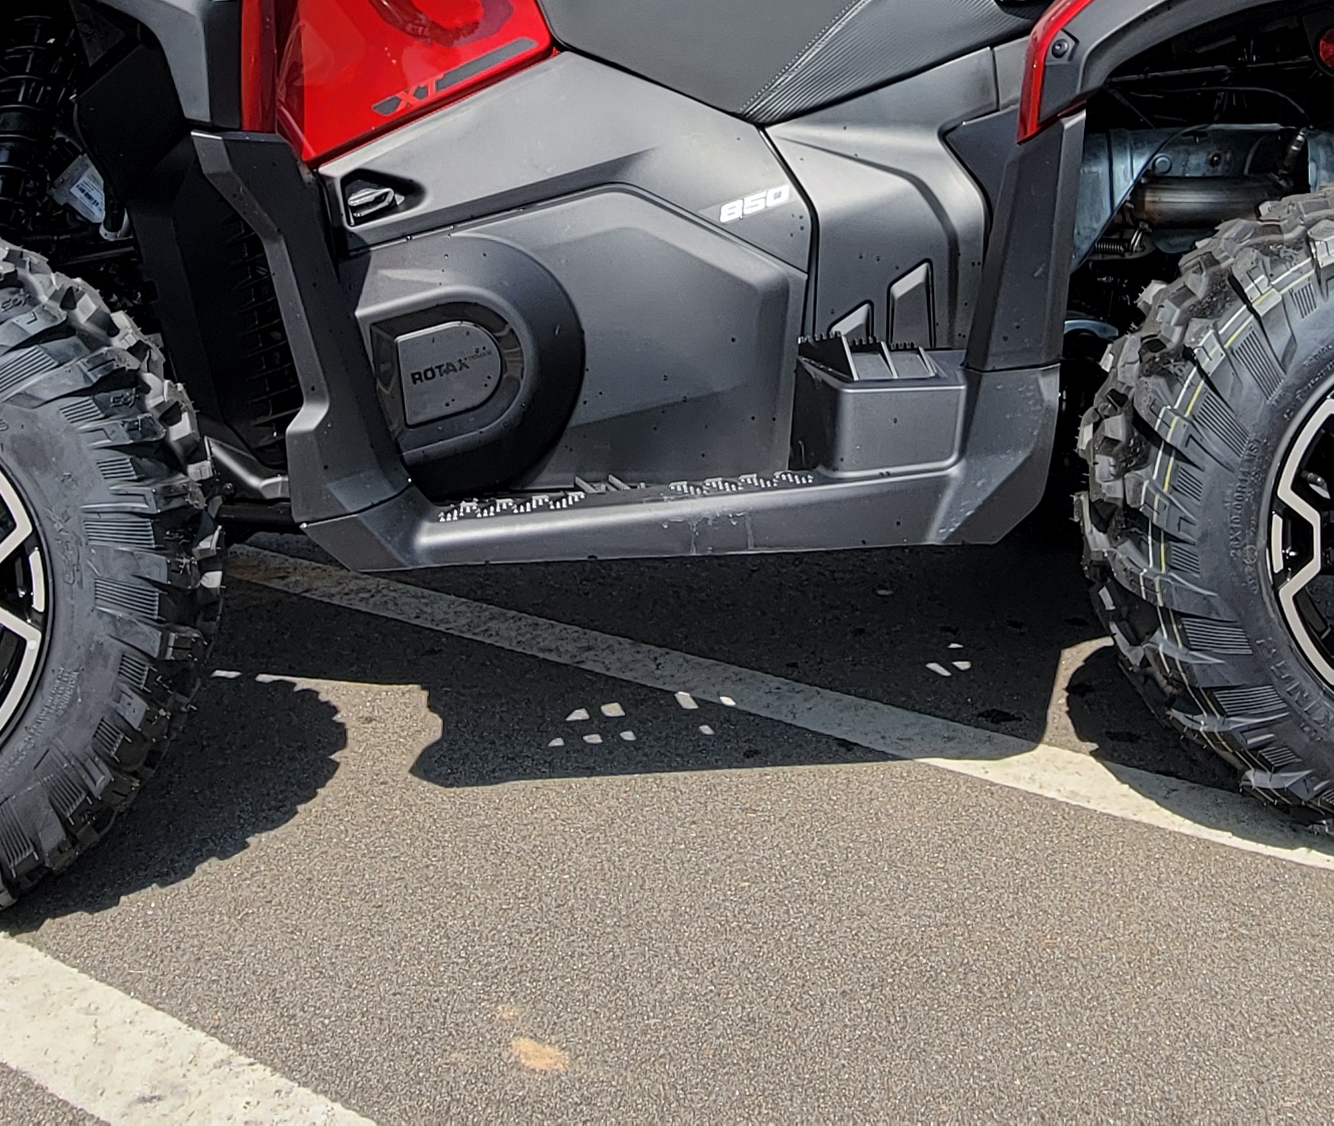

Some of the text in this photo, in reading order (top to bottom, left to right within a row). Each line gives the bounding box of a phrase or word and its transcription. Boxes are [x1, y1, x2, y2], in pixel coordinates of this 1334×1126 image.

[395, 73, 445, 113] XT
[719, 184, 790, 223] 850
[409, 358, 471, 386] ROTAX
